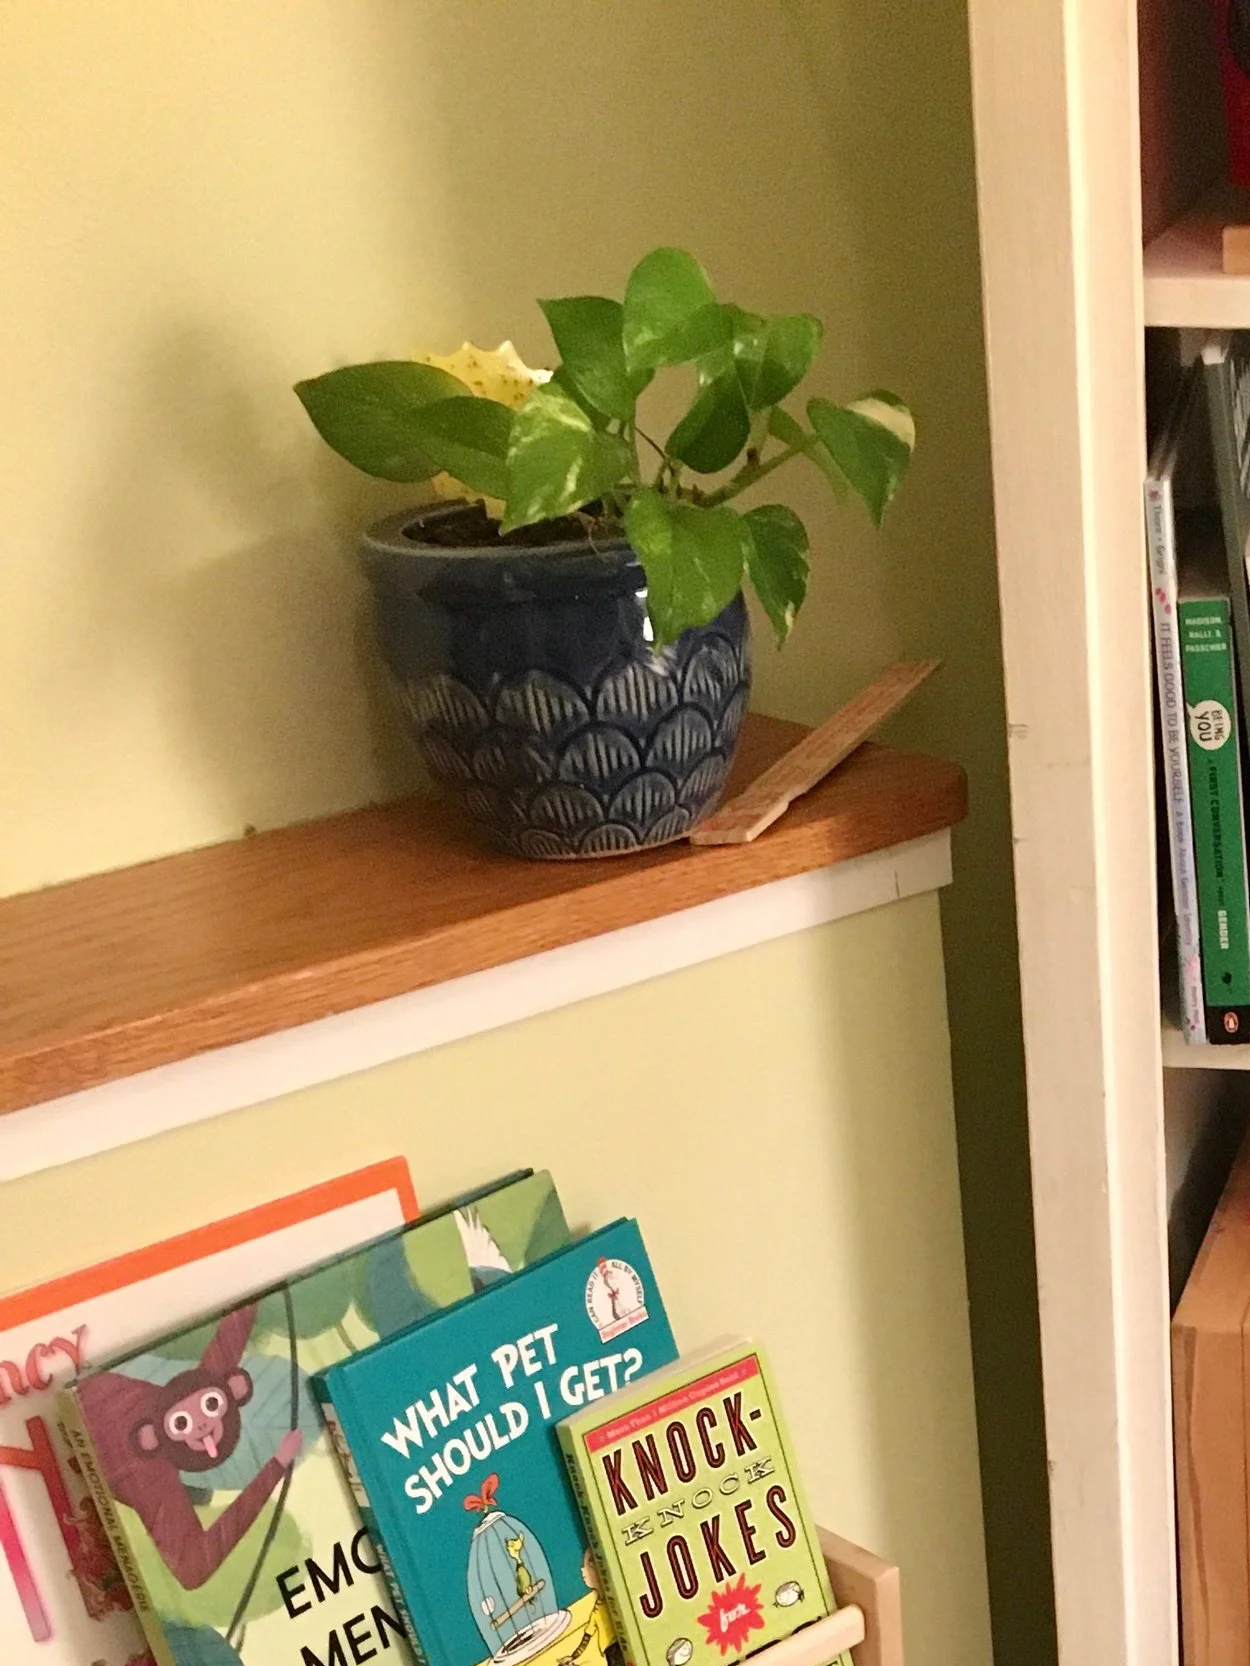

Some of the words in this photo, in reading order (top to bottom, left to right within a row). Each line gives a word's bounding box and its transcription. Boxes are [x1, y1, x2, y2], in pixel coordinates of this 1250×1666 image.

[1160, 622, 1171, 633] IT
[1161, 635, 1173, 673] FEELS
[1163, 673, 1176, 709] GOOD
[1166, 711, 1178, 728] TO
[1167, 728, 1180, 745] BE
[1194, 711, 1212, 743] YOU
[1211, 709, 1223, 741] BEING
[1168, 745, 1184, 804] YOURSELF
[1208, 766, 1219, 796] FIRST
[1217, 909, 1230, 950] GENDER
[380, 1362, 481, 1460] WHAT
[490, 1322, 559, 1390] PET
[404, 1401, 530, 1515] SHOULD
[534, 1380, 551, 1420] I
[559, 1347, 644, 1407] GET?
[601, 1391, 762, 1516] KNOCK-
[80, 1451, 118, 1534] EMOTIONAL
[621, 1456, 776, 1546] KNOCK
[638, 1484, 797, 1619] JOKES
[719, 1605, 752, 1633] for
